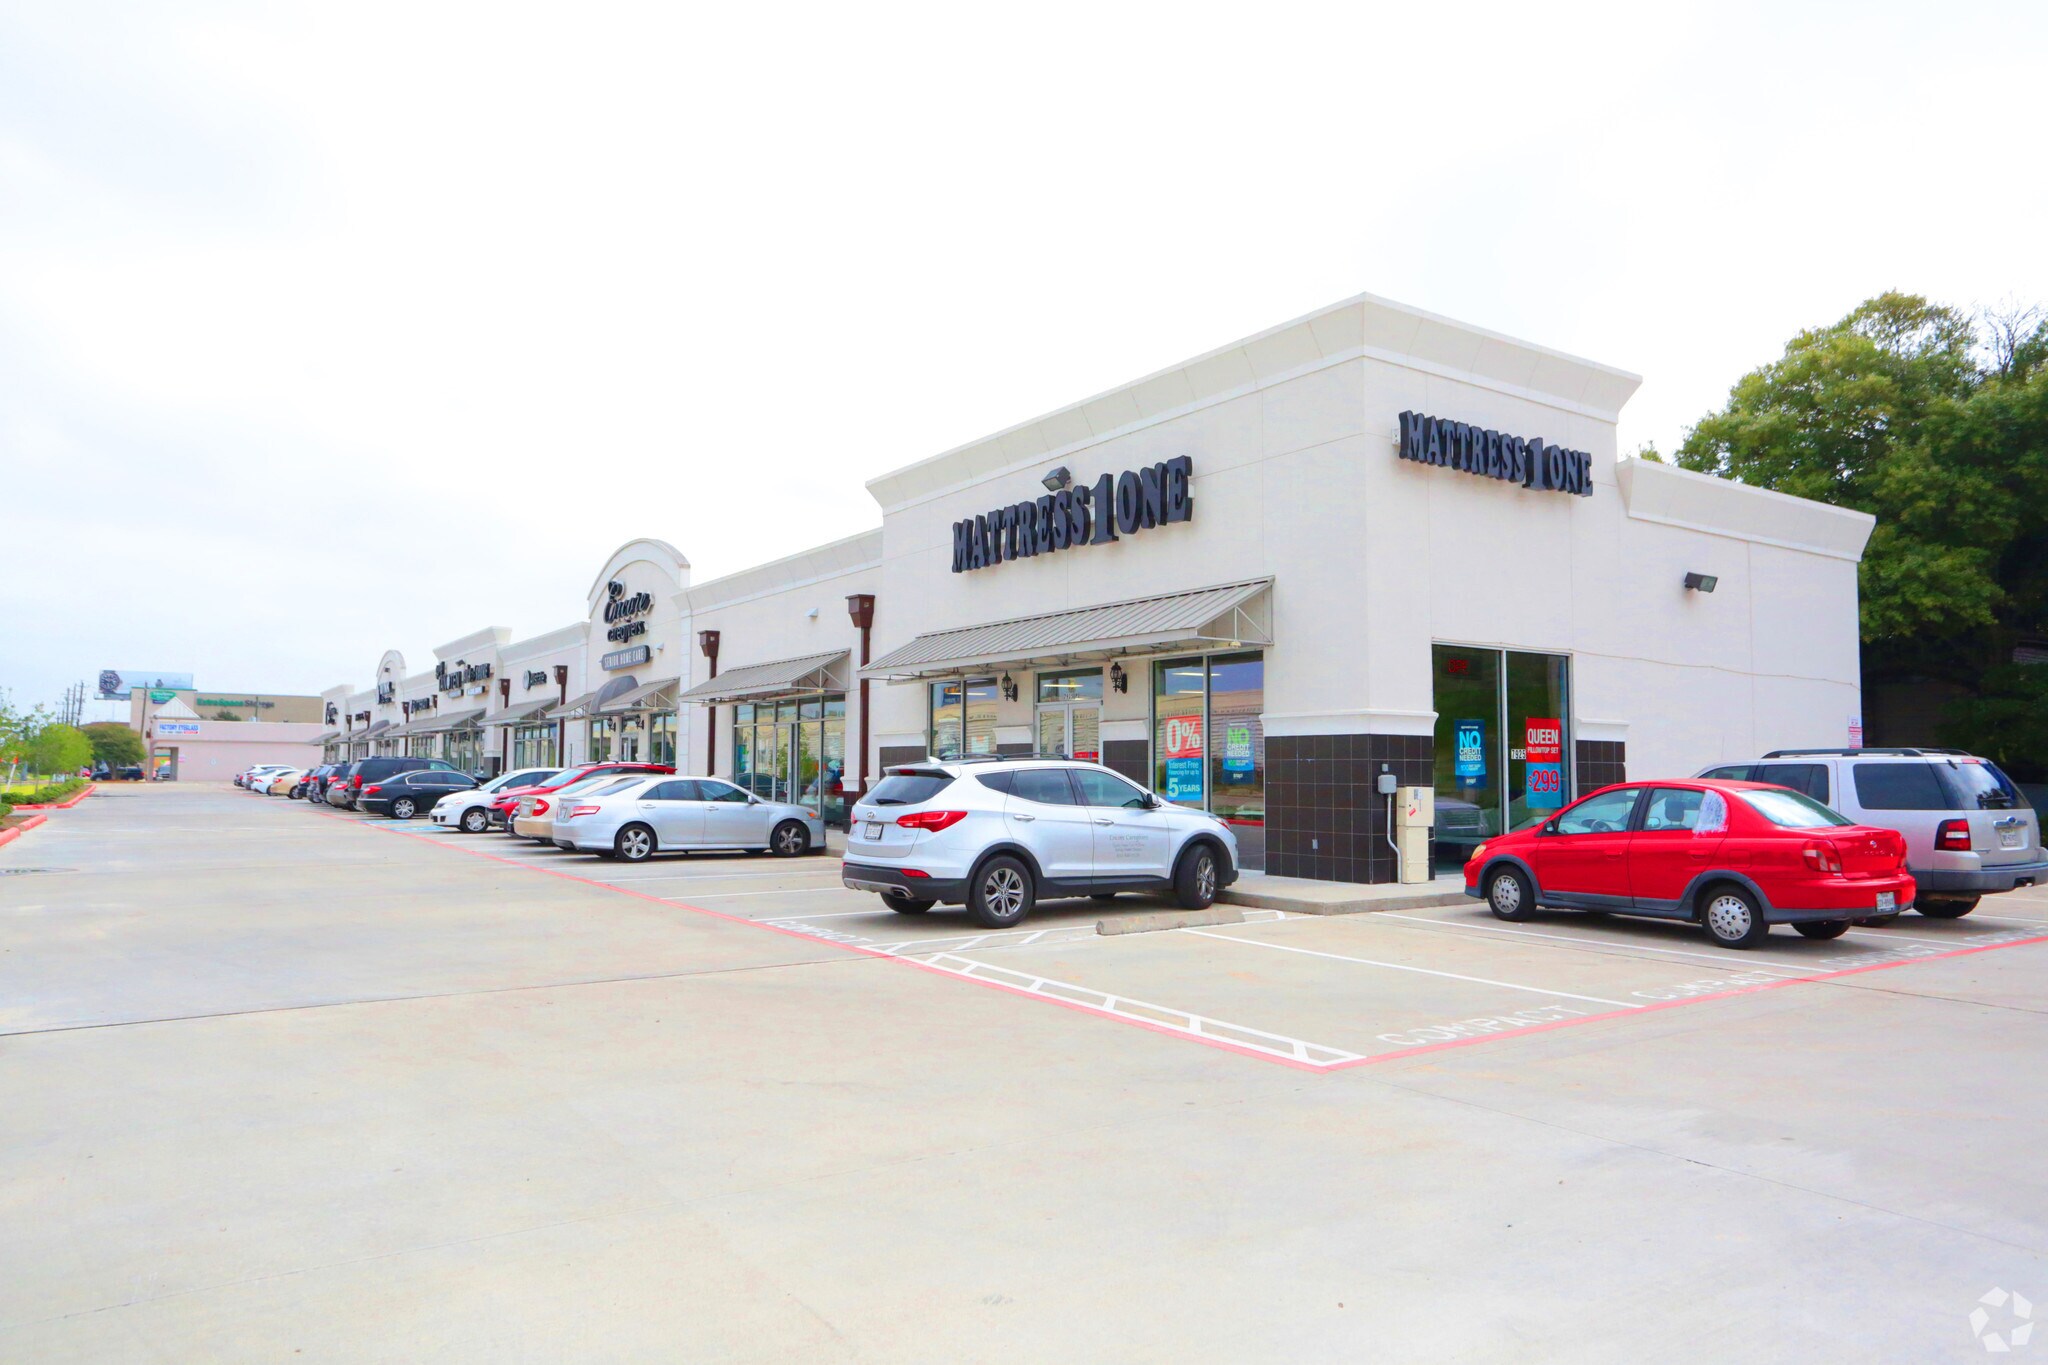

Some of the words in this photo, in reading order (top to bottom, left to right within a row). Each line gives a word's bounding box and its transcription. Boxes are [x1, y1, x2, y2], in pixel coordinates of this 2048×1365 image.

[604, 654, 619, 669] SENIOR
[620, 651, 632, 665] HOME
[632, 648, 644, 662] CARE
[1166, 719, 1201, 753] 0%
[1227, 727, 1250, 745] NO
[1459, 730, 1481, 749] NO
[1527, 728, 1559, 744] QUEEN
[1227, 743, 1250, 751] CREDIT
[1459, 747, 1482, 755] CREDIT
[1550, 746, 1559, 754] SET
[1168, 760, 1187, 769] Interest
[1187, 760, 1200, 769] Free
[1459, 754, 1482, 762] NEEDED
[1168, 777, 1179, 798] 5
[1179, 784, 1201, 792] YEARS
[1528, 769, 1560, 793] $299
[1375, 1004, 1588, 1046] COMPACT
